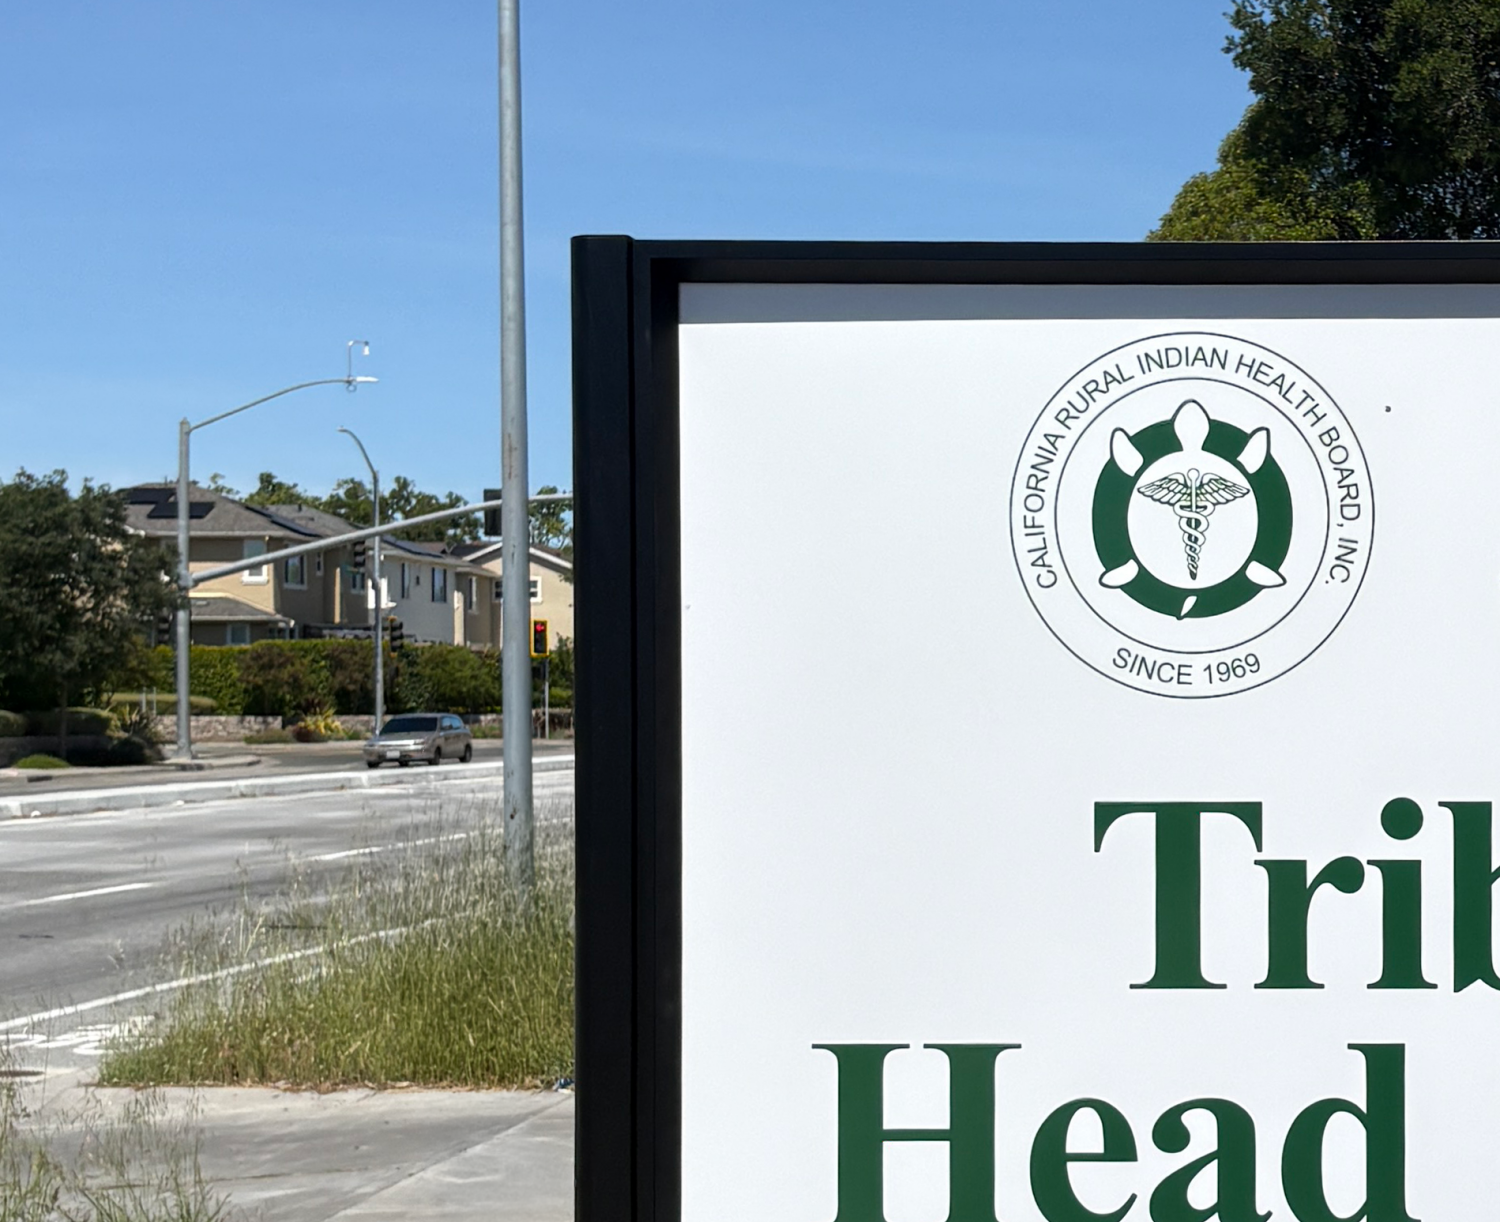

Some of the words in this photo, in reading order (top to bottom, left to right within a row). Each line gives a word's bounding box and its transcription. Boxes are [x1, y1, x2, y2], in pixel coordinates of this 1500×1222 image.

[1136, 346, 1229, 375] INDIAN
[1234, 353, 1327, 427] HEALTH
[1054, 363, 1134, 431] RURAL
[1023, 432, 1066, 589] CALIFORNIA
[1318, 426, 1361, 528] BOARD,
[1324, 536, 1359, 585] INC.
[1112, 647, 1193, 685] SINCE
[1203, 652, 1261, 685] 1969
